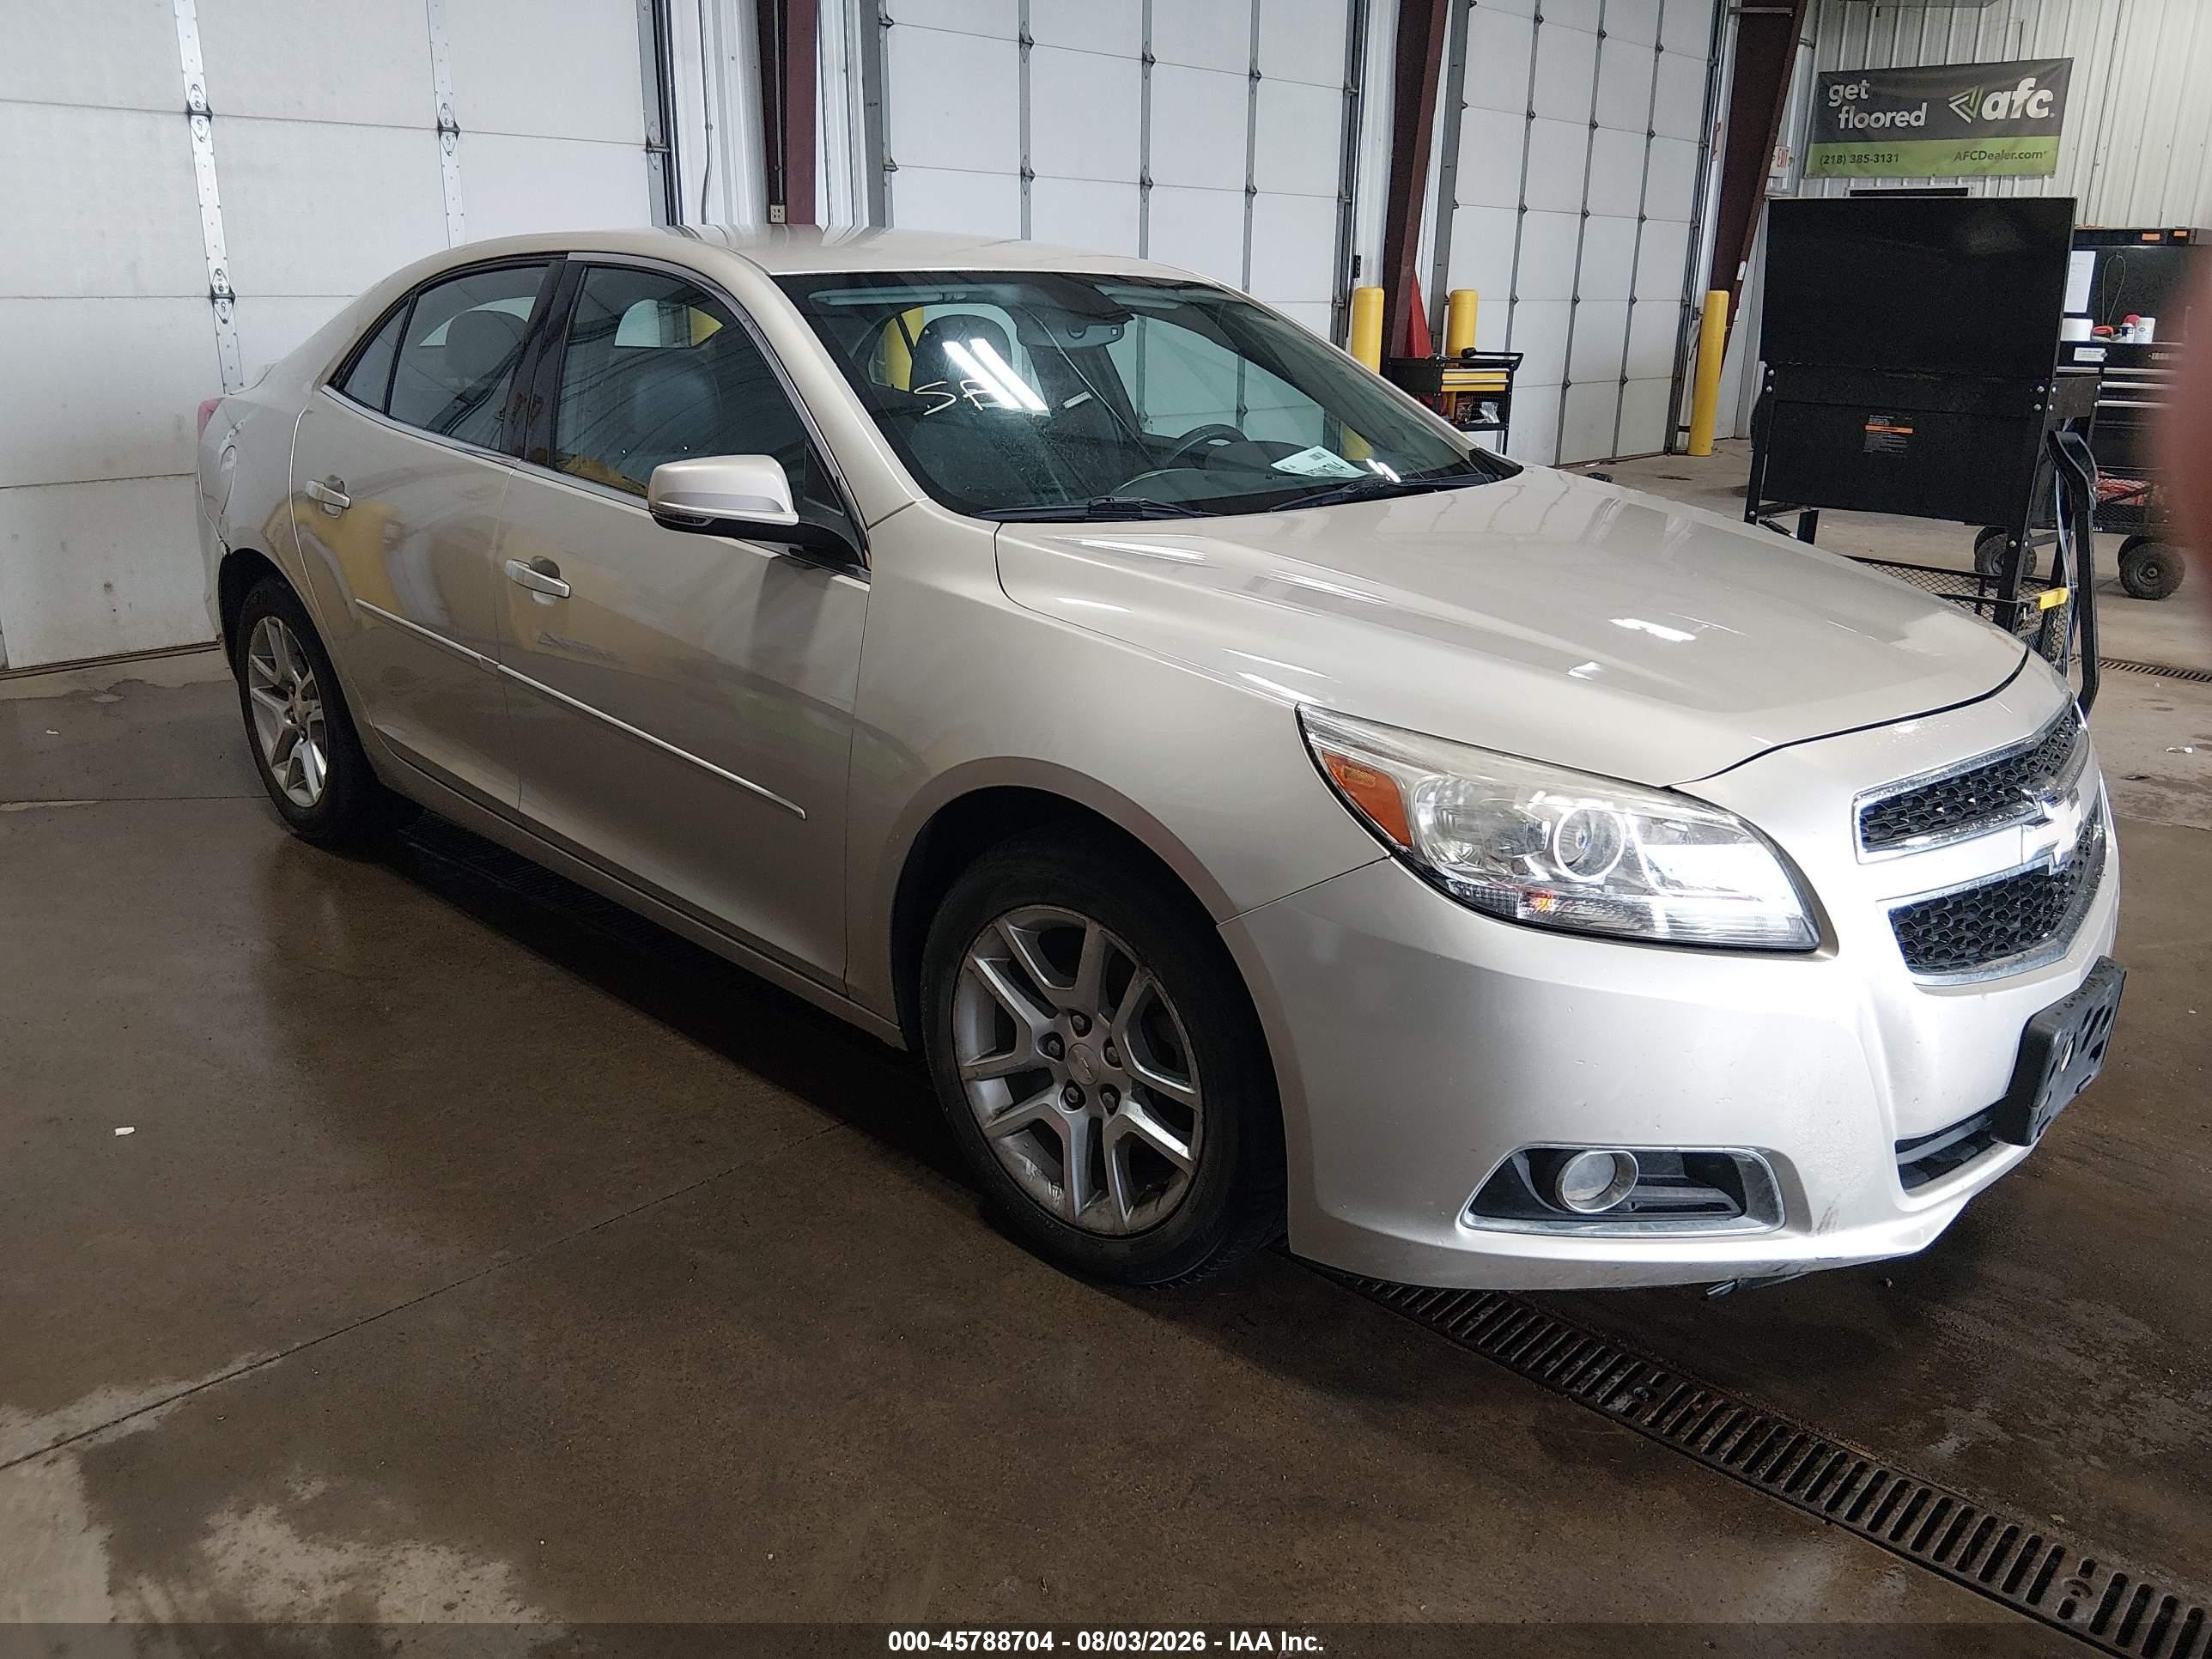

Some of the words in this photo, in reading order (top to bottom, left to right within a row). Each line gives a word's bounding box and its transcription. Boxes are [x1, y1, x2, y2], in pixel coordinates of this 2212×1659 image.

[1828, 79, 1869, 107] get
[1981, 77, 2053, 120] afc
[1838, 102, 1927, 129] floored
[1820, 154, 1846, 165] (218)
[1850, 153, 1899, 164] 385-3131
